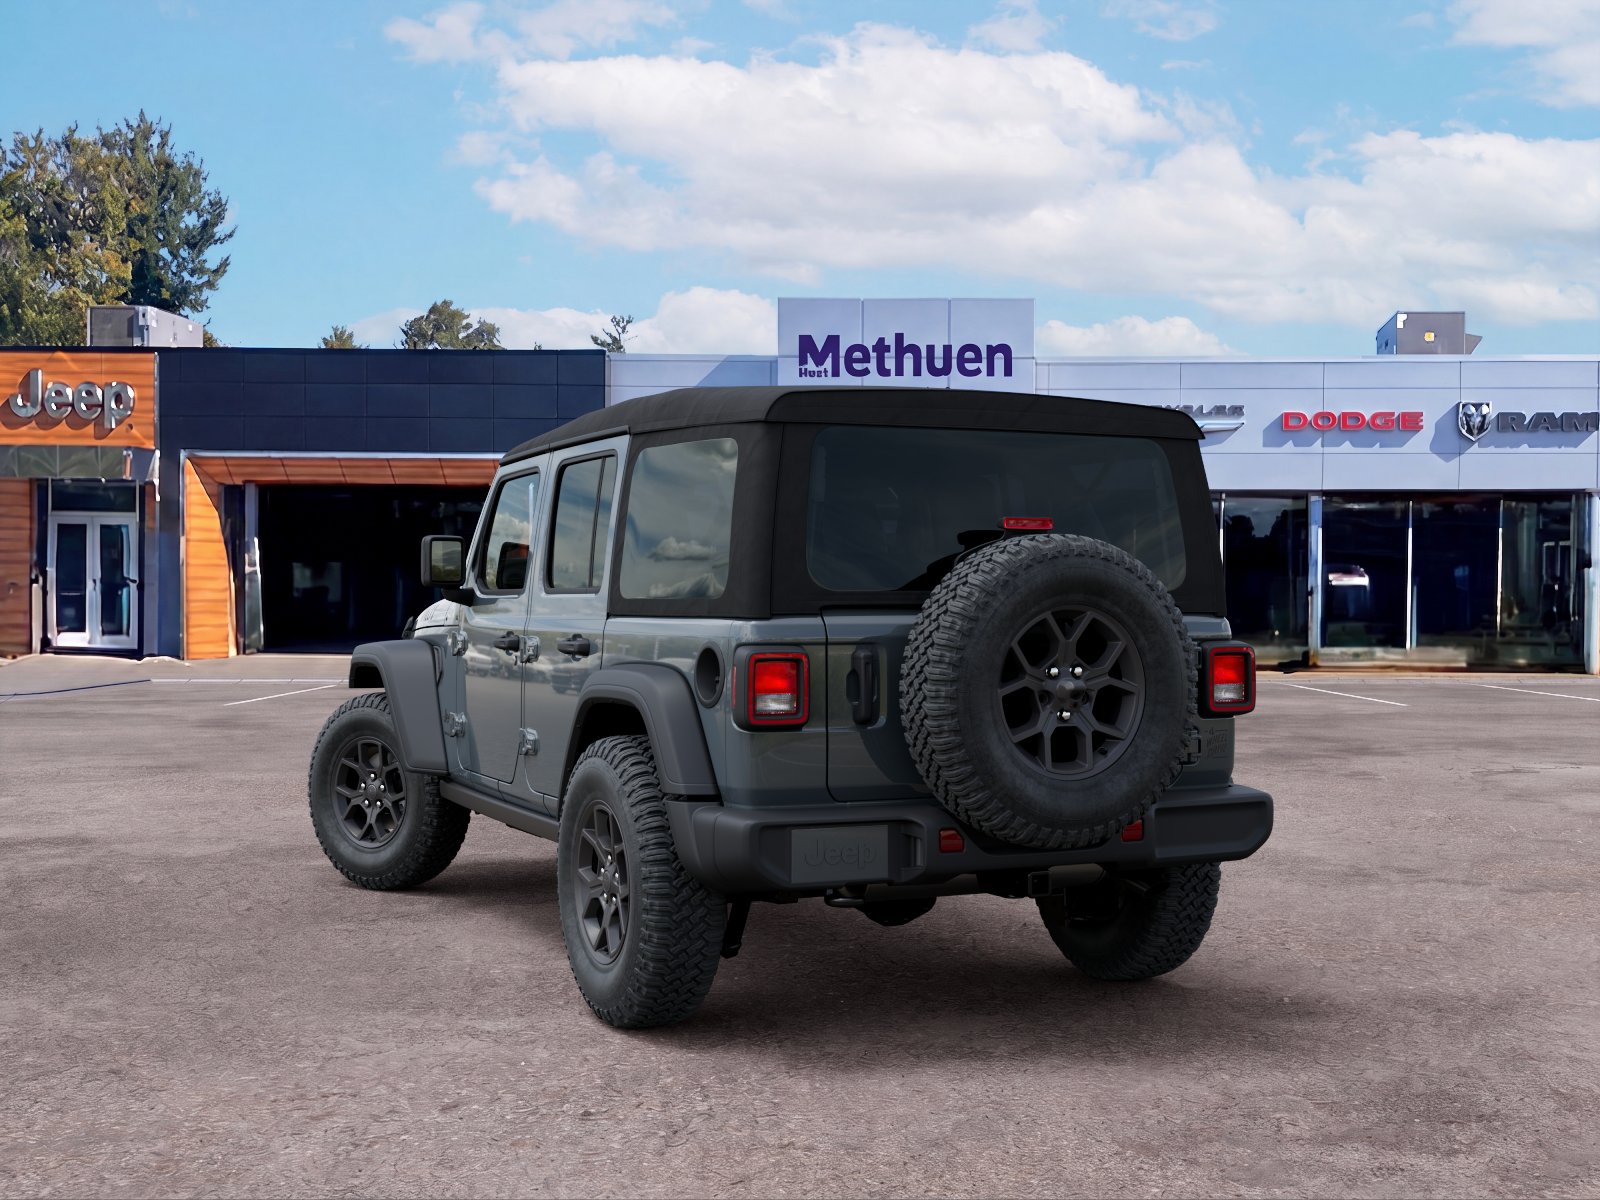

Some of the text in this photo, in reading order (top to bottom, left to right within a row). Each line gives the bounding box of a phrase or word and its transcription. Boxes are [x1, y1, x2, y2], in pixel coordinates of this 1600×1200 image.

[798, 332, 1013, 378] Methuen
[9, 368, 135, 429] Jeep
[1282, 411, 1424, 431] DODGE
[1498, 411, 1600, 432] RAM
[802, 839, 878, 870] Jeep
